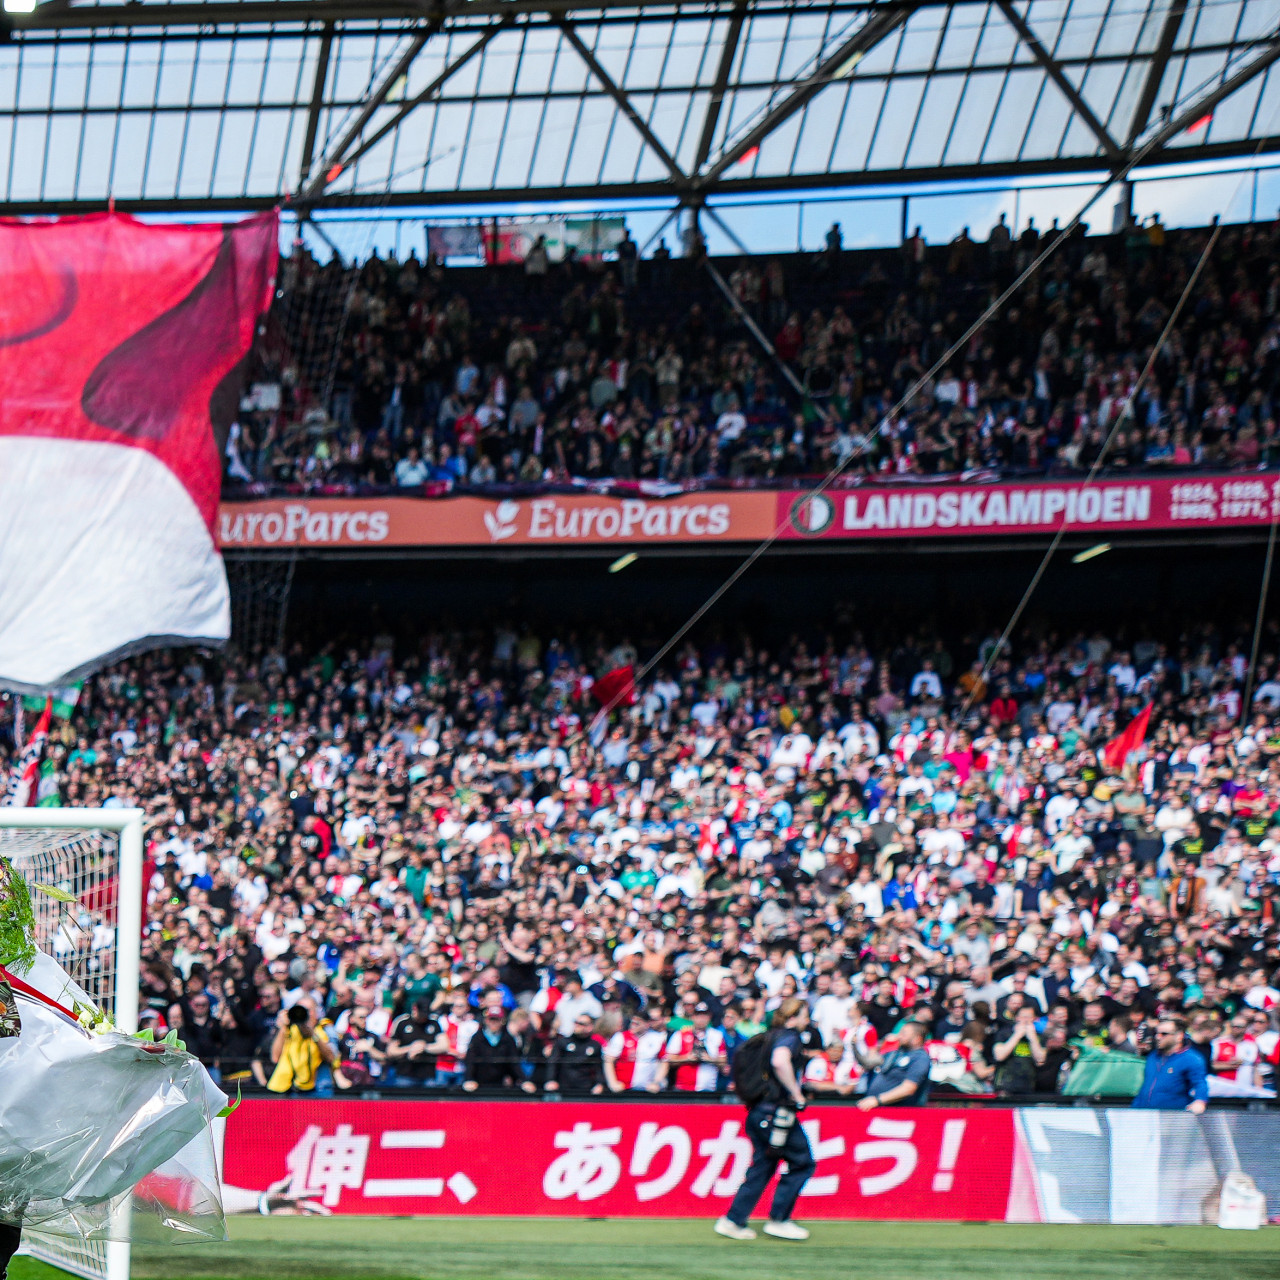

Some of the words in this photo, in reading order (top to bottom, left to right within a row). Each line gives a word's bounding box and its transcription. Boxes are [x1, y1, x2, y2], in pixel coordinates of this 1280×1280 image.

[220, 506, 389, 542] uroParcs
[528, 502, 729, 538] EuroParcs
[844, 486, 1151, 530] LANDSKAMPIOEN
